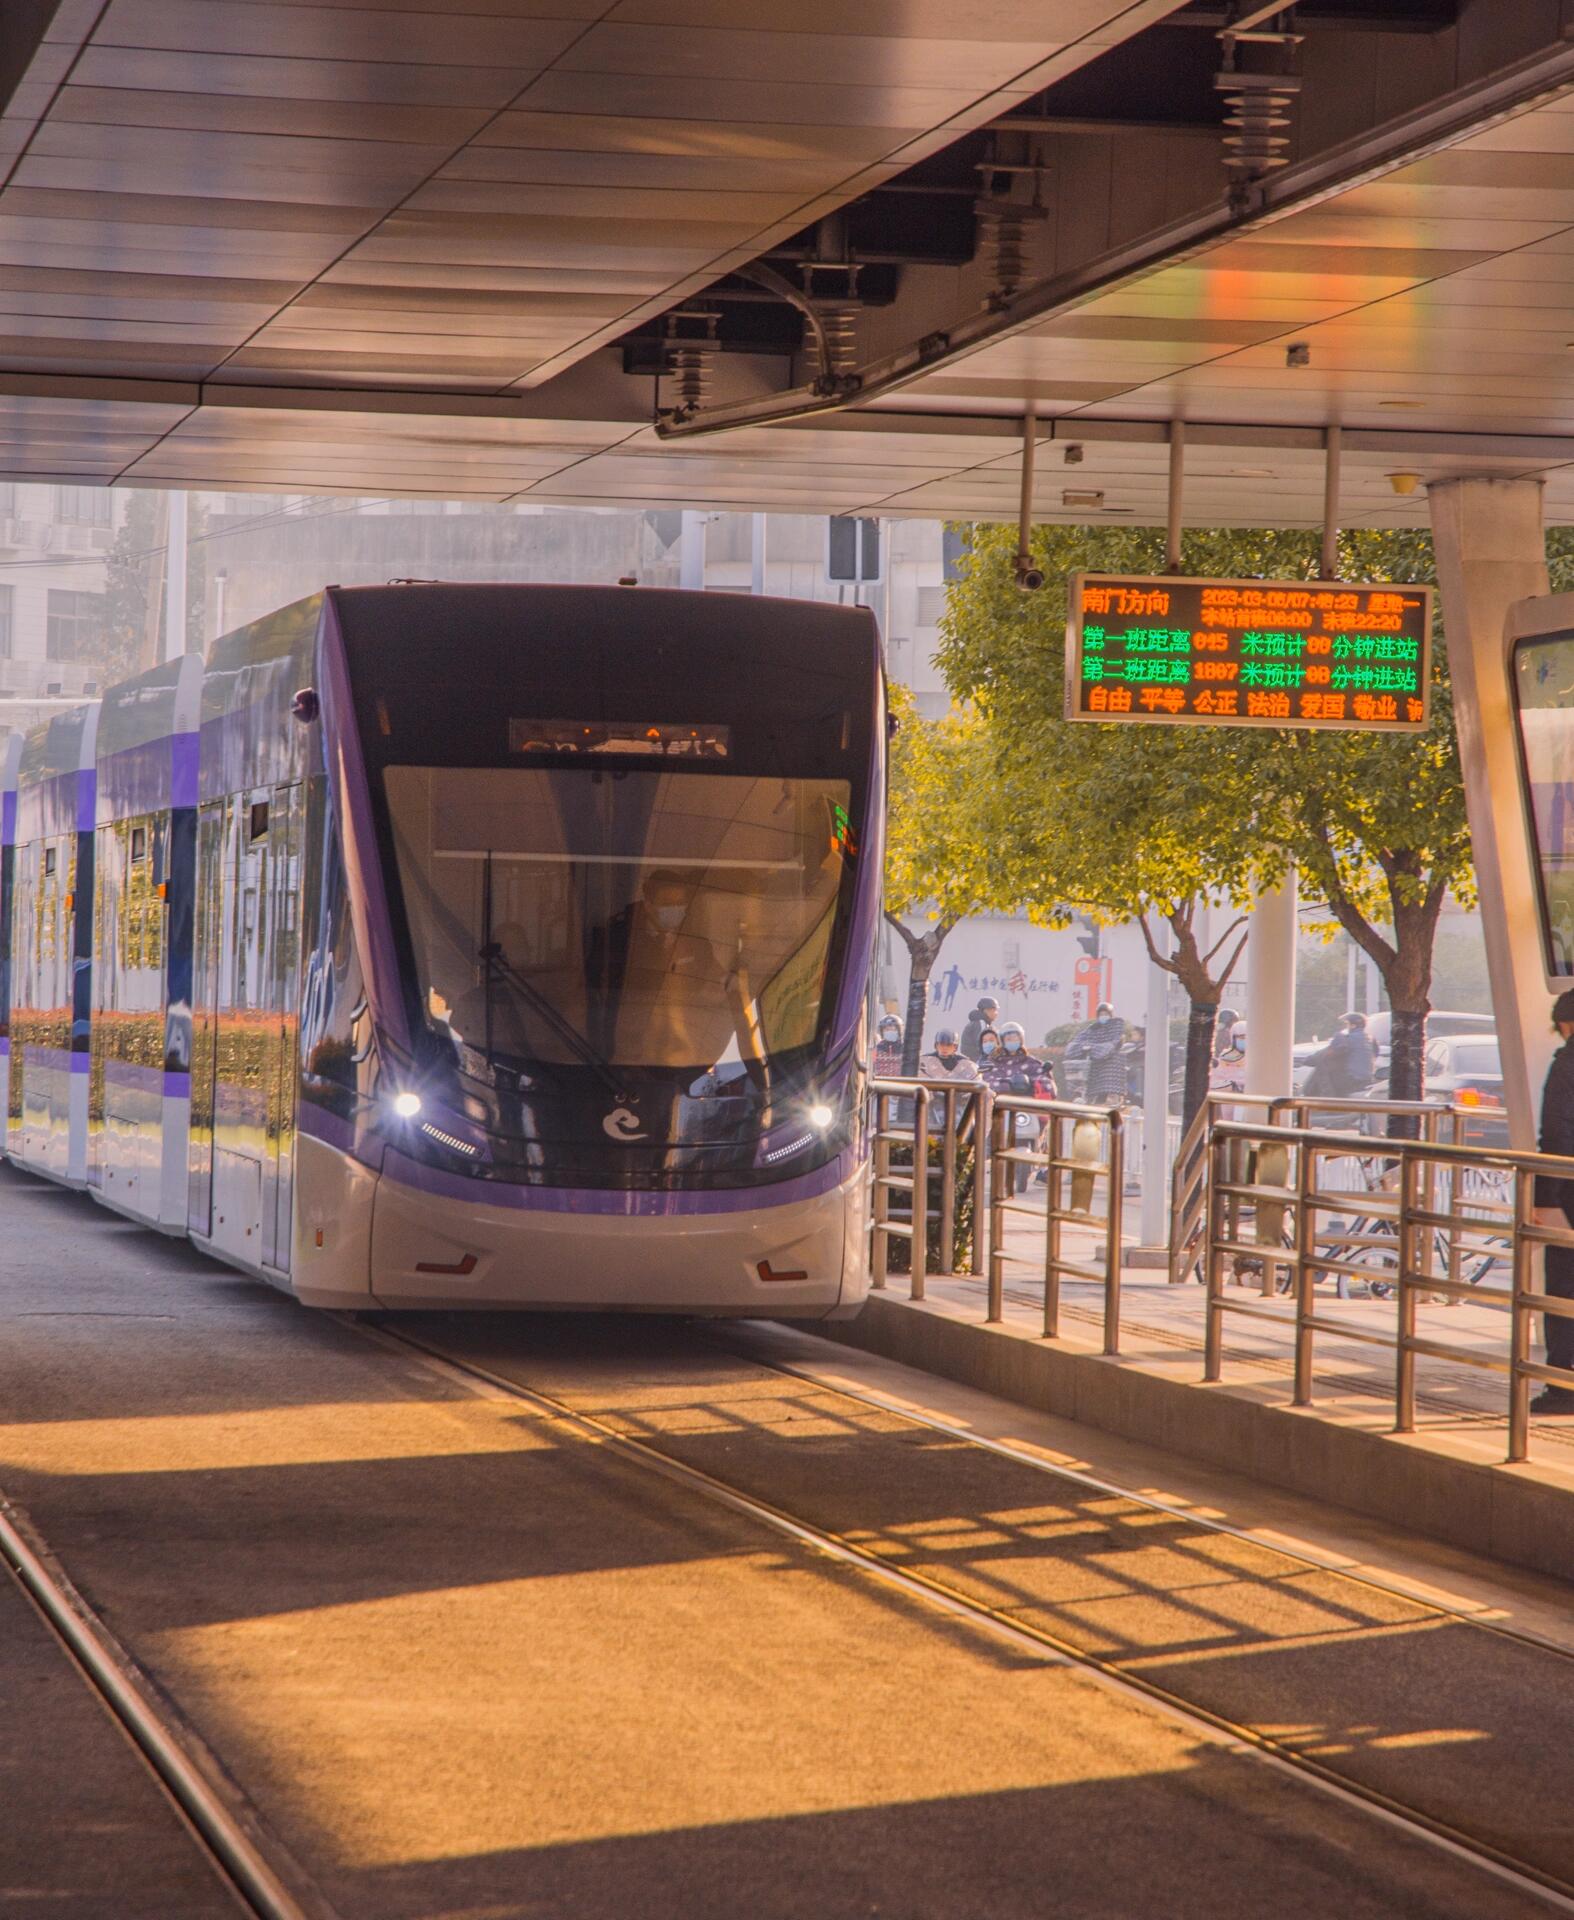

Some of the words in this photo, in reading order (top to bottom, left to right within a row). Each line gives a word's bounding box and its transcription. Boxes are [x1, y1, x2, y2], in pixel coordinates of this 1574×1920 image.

[1080, 588, 1169, 615] 南门方向
[1090, 686, 1131, 711] 自由
[1140, 688, 1185, 713] 平等
[1193, 690, 1237, 714] 公正
[1248, 692, 1290, 717] 法治
[1300, 693, 1345, 720] 爱国
[1353, 695, 1396, 720] 敬业
